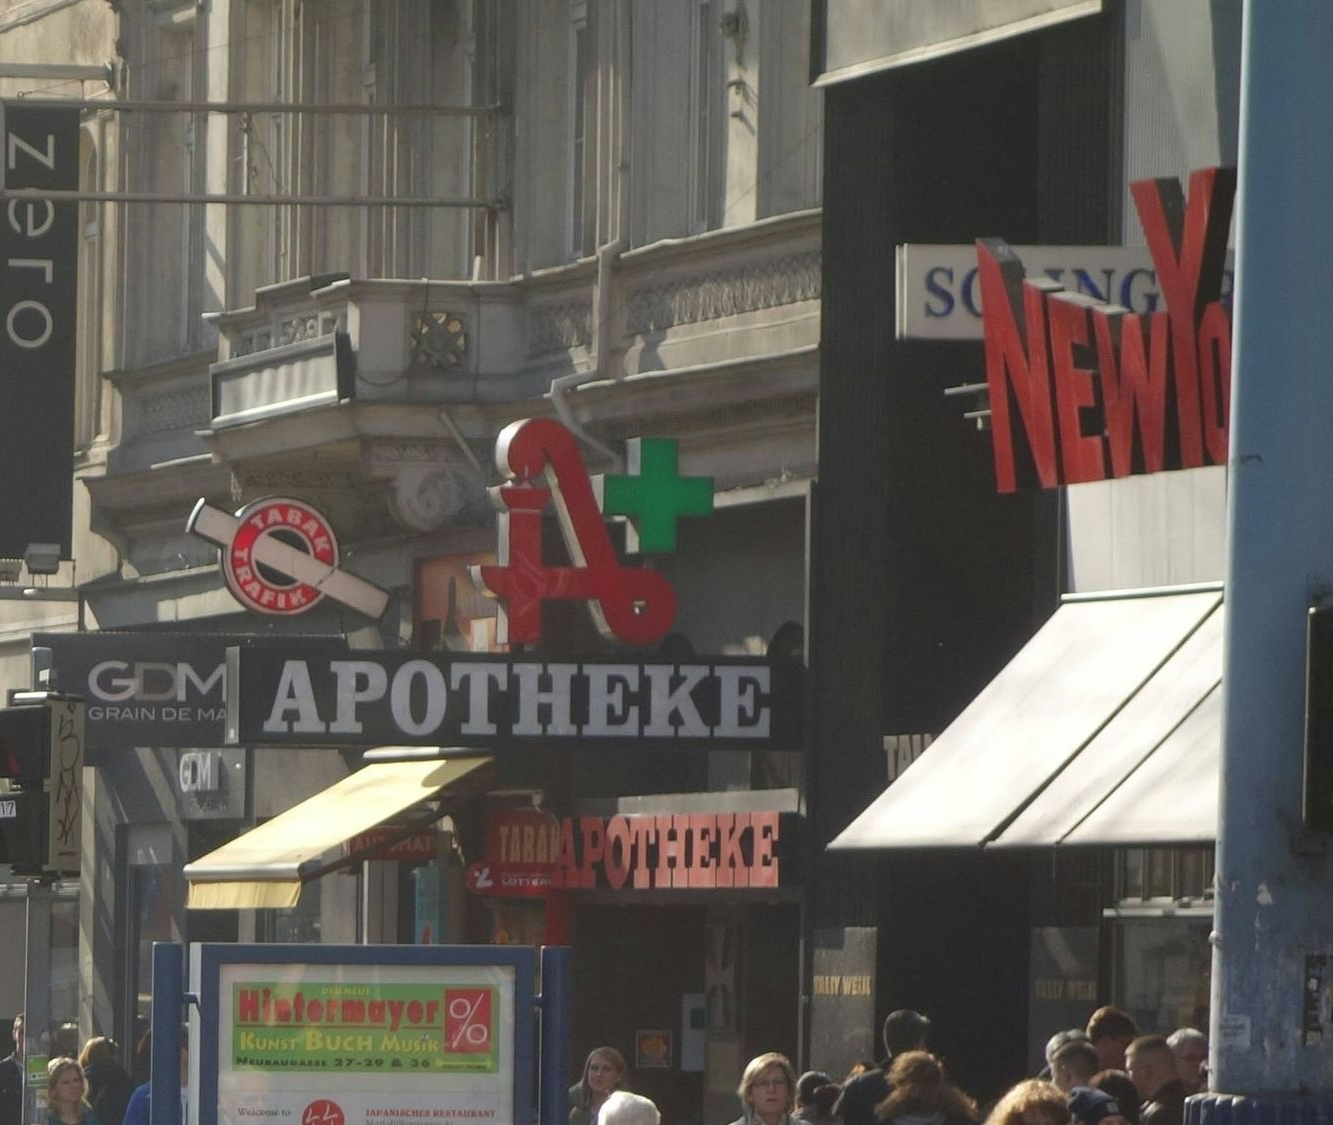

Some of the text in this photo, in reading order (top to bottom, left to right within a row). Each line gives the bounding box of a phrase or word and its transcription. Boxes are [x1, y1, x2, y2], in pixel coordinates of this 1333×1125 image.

[7, 132, 55, 348] zero
[250, 508, 330, 557] TABAK
[234, 548, 307, 609] TRAFIK
[88, 660, 226, 702] GDM
[263, 660, 771, 738] APOTHEKE
[88, 707, 155, 720] GRAIN
[162, 708, 191, 721] DE
[555, 812, 780, 890] APOTHEKE
[237, 1107, 291, 1117] Welcome to
[366, 1108, 496, 1118] JAPANISCHES RESTAURANT
